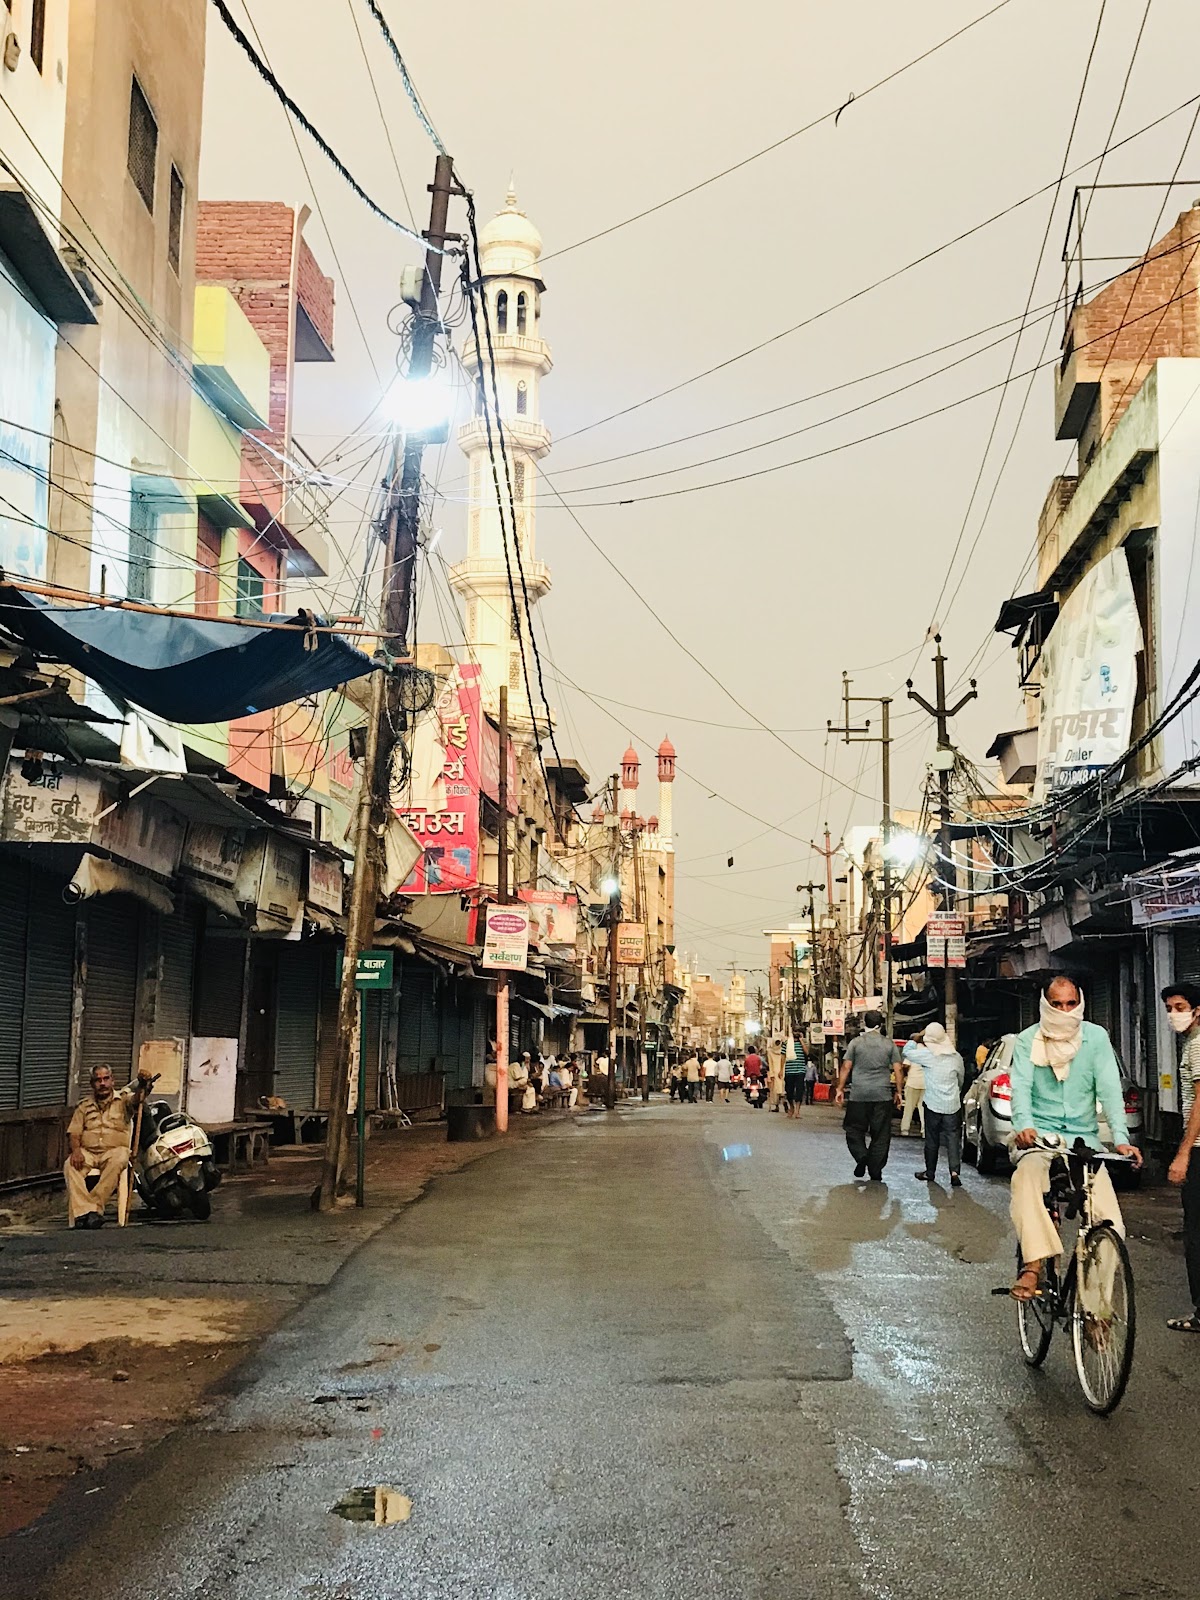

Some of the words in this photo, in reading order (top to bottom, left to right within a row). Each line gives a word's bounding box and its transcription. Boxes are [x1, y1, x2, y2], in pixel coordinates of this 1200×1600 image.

[619, 937, 644, 945] चप्पल
[489, 950, 523, 962] सर्वेक्षण
[620, 947, 642, 957] हाउस
[363, 959, 387, 969] बाजार
